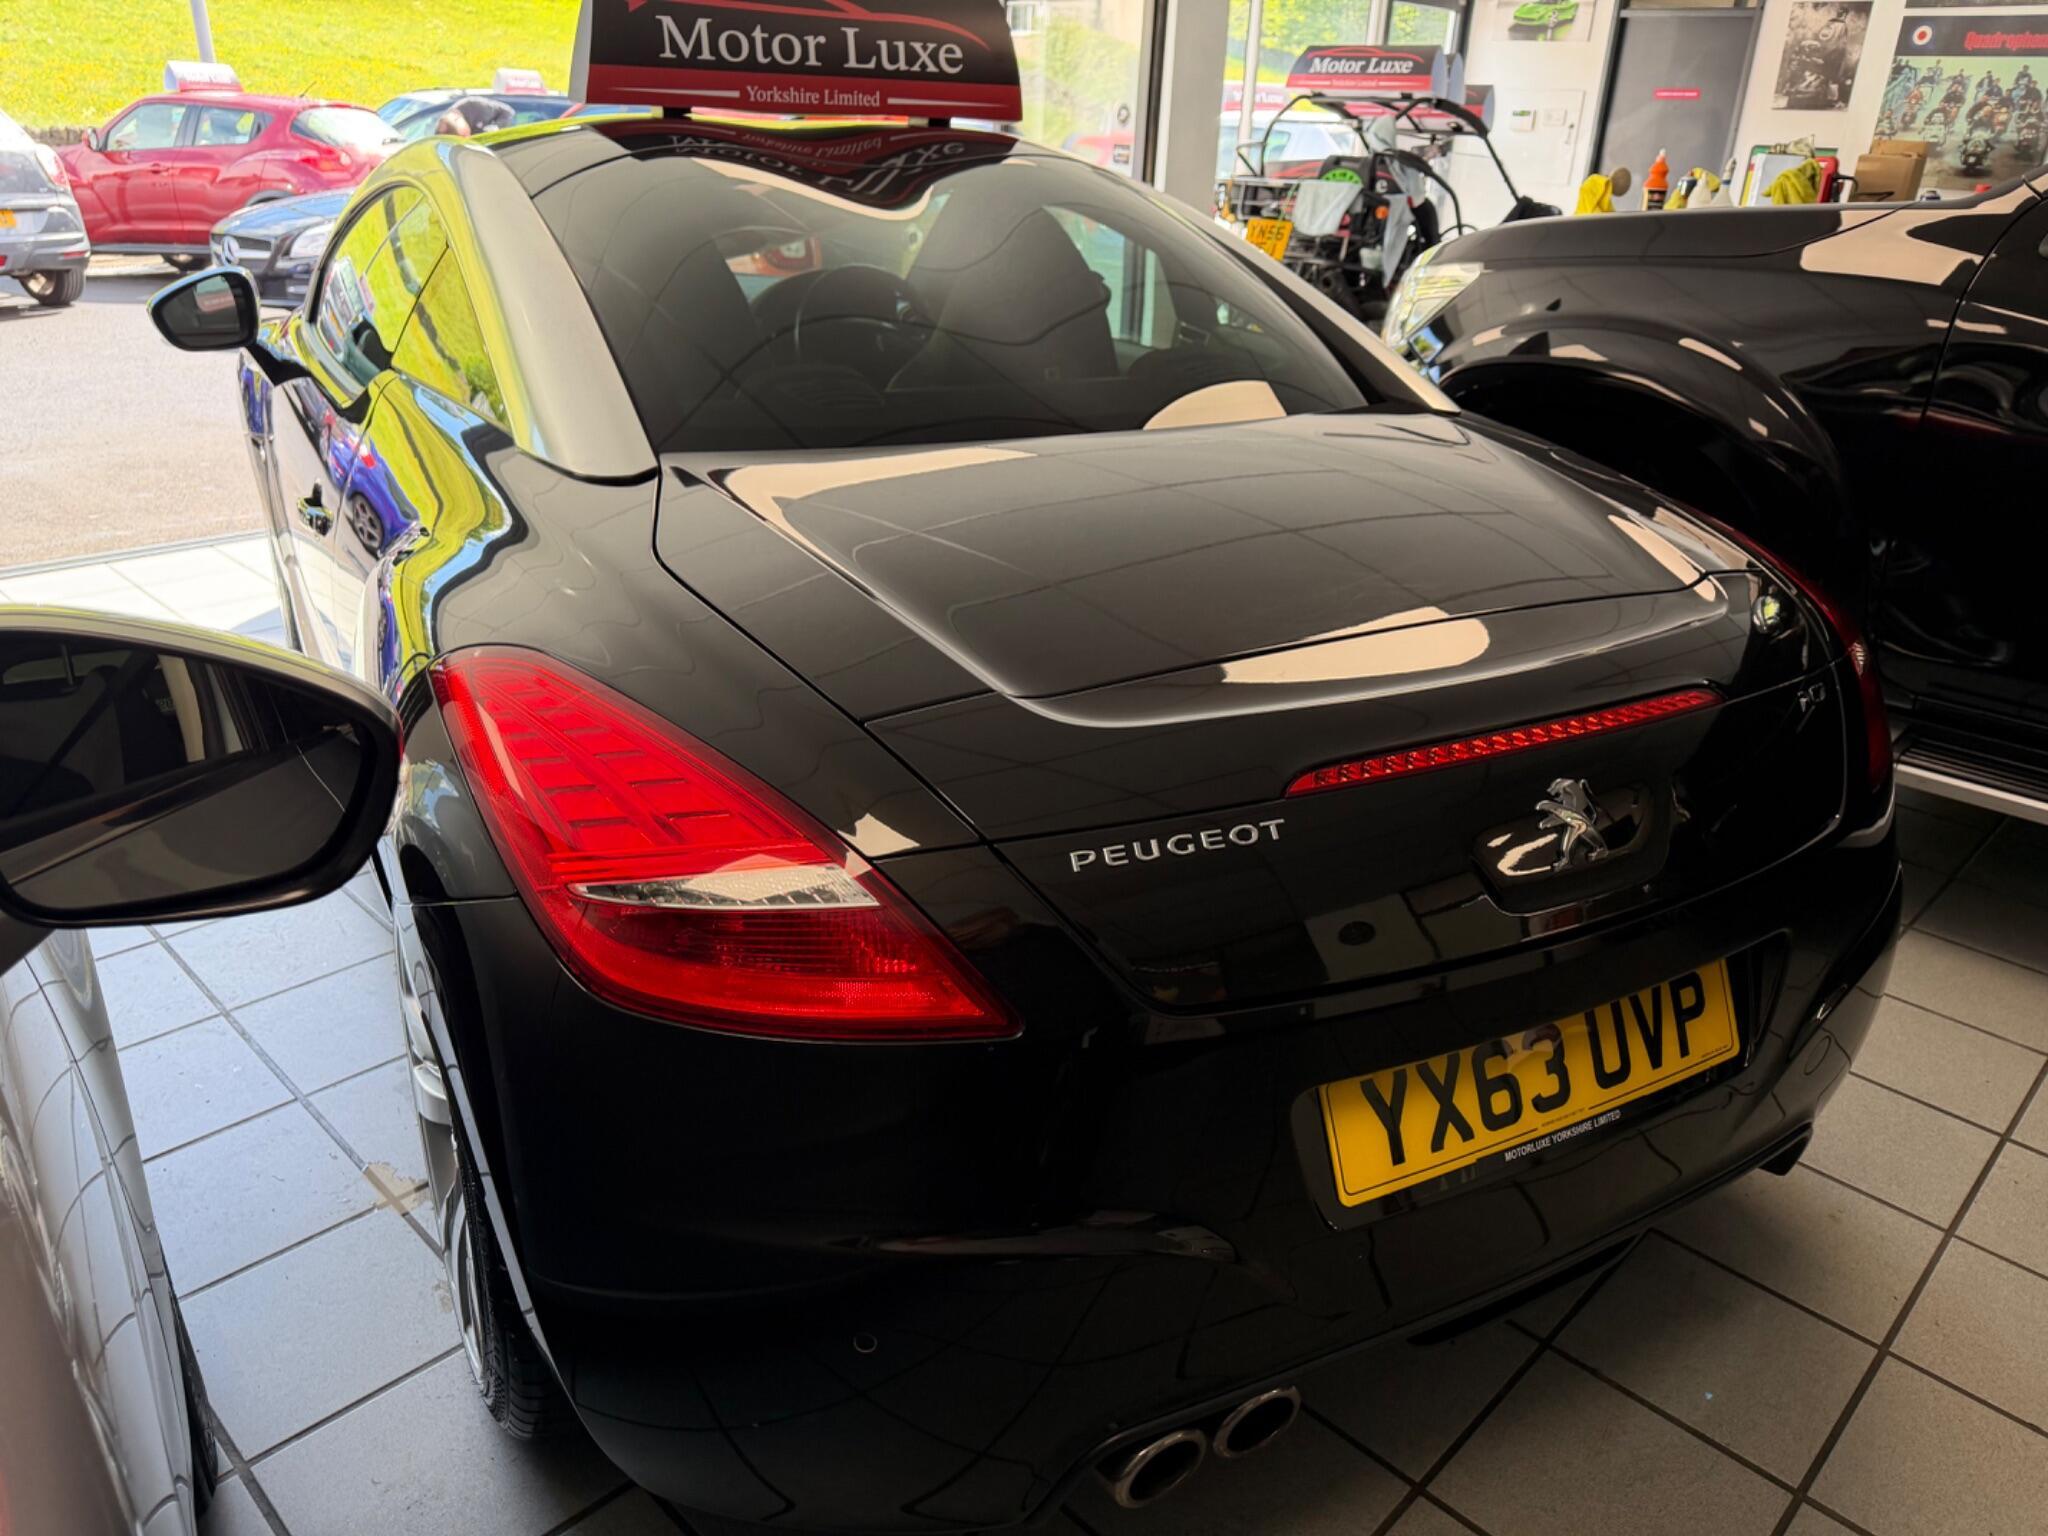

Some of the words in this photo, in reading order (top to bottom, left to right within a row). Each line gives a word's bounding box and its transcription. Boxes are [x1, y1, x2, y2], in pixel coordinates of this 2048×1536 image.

[655, 14, 827, 68] Motor
[840, 25, 964, 74] Luxe
[1308, 56, 1366, 74] Motor
[1366, 56, 1414, 74] Luxe
[746, 85, 821, 105] Yorkshire
[823, 87, 881, 108] Limited
[1068, 818, 1286, 873] PEUGEOT
[1359, 1022, 1572, 1167] YX63
[1583, 970, 1706, 1090] UVP
[1503, 1135, 1552, 1162] MOTORLUXE
[1551, 1119, 1594, 1145] YORKSHIRE
[1593, 1109, 1621, 1129] LIMITED
